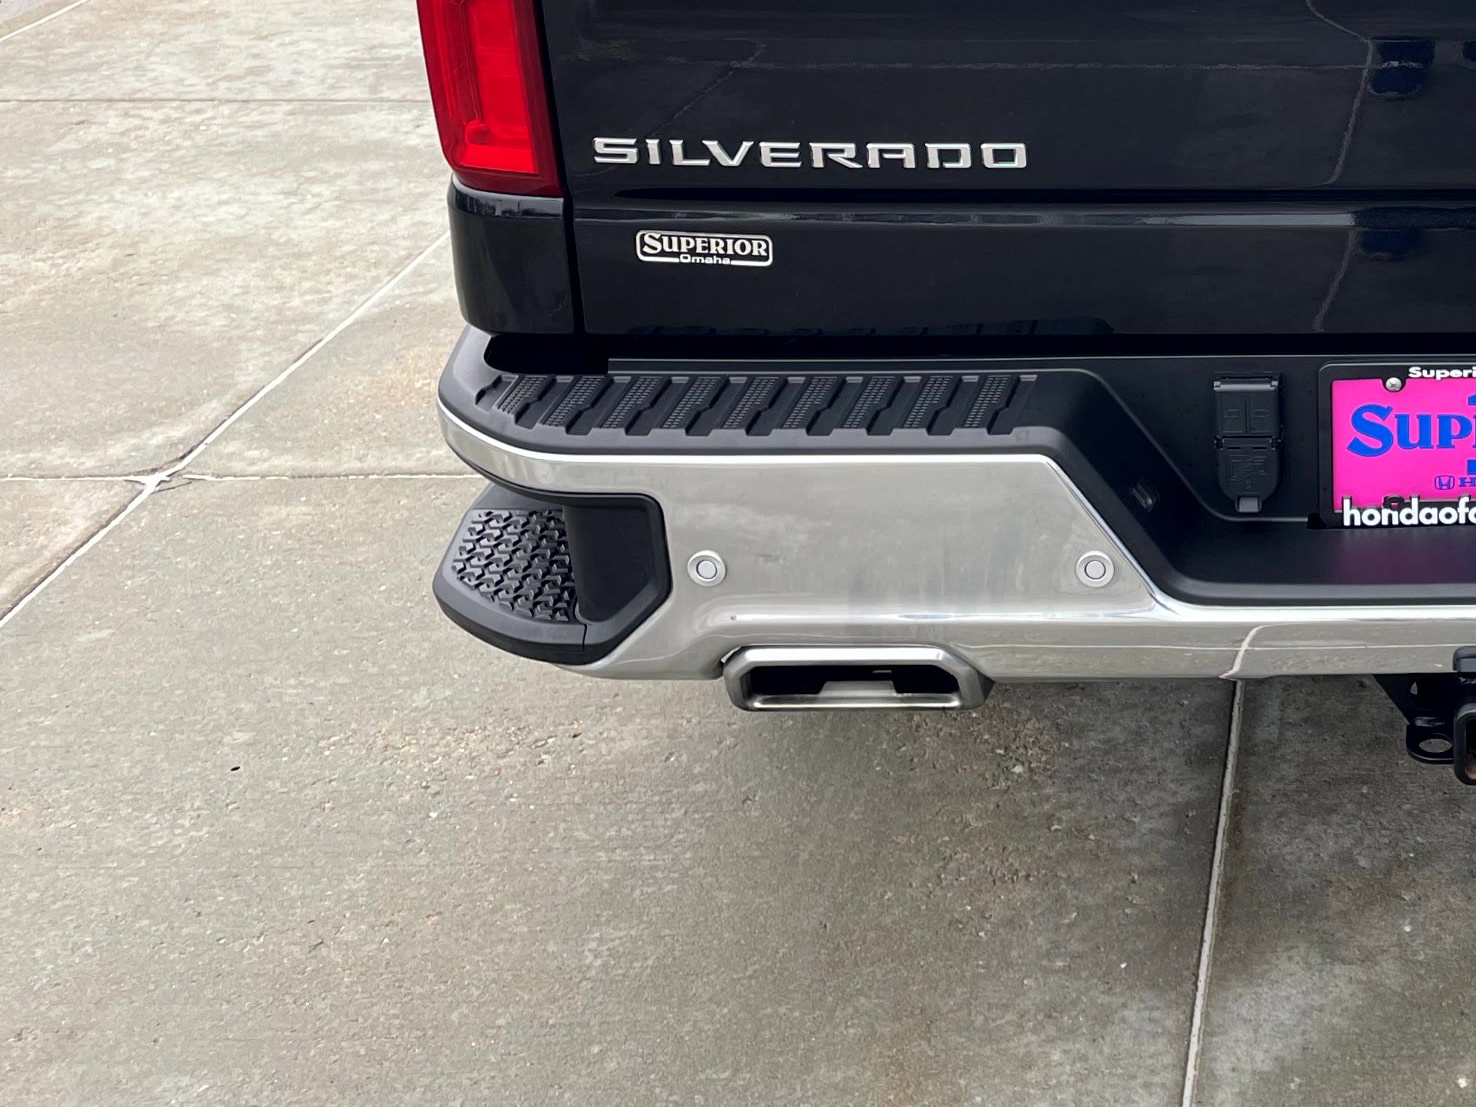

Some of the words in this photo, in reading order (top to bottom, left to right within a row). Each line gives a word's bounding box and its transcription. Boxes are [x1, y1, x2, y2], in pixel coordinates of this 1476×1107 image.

[593, 137, 1027, 169] SILVERADO
[642, 233, 768, 256] SUPERIOR
[679, 254, 732, 265] Omaha
